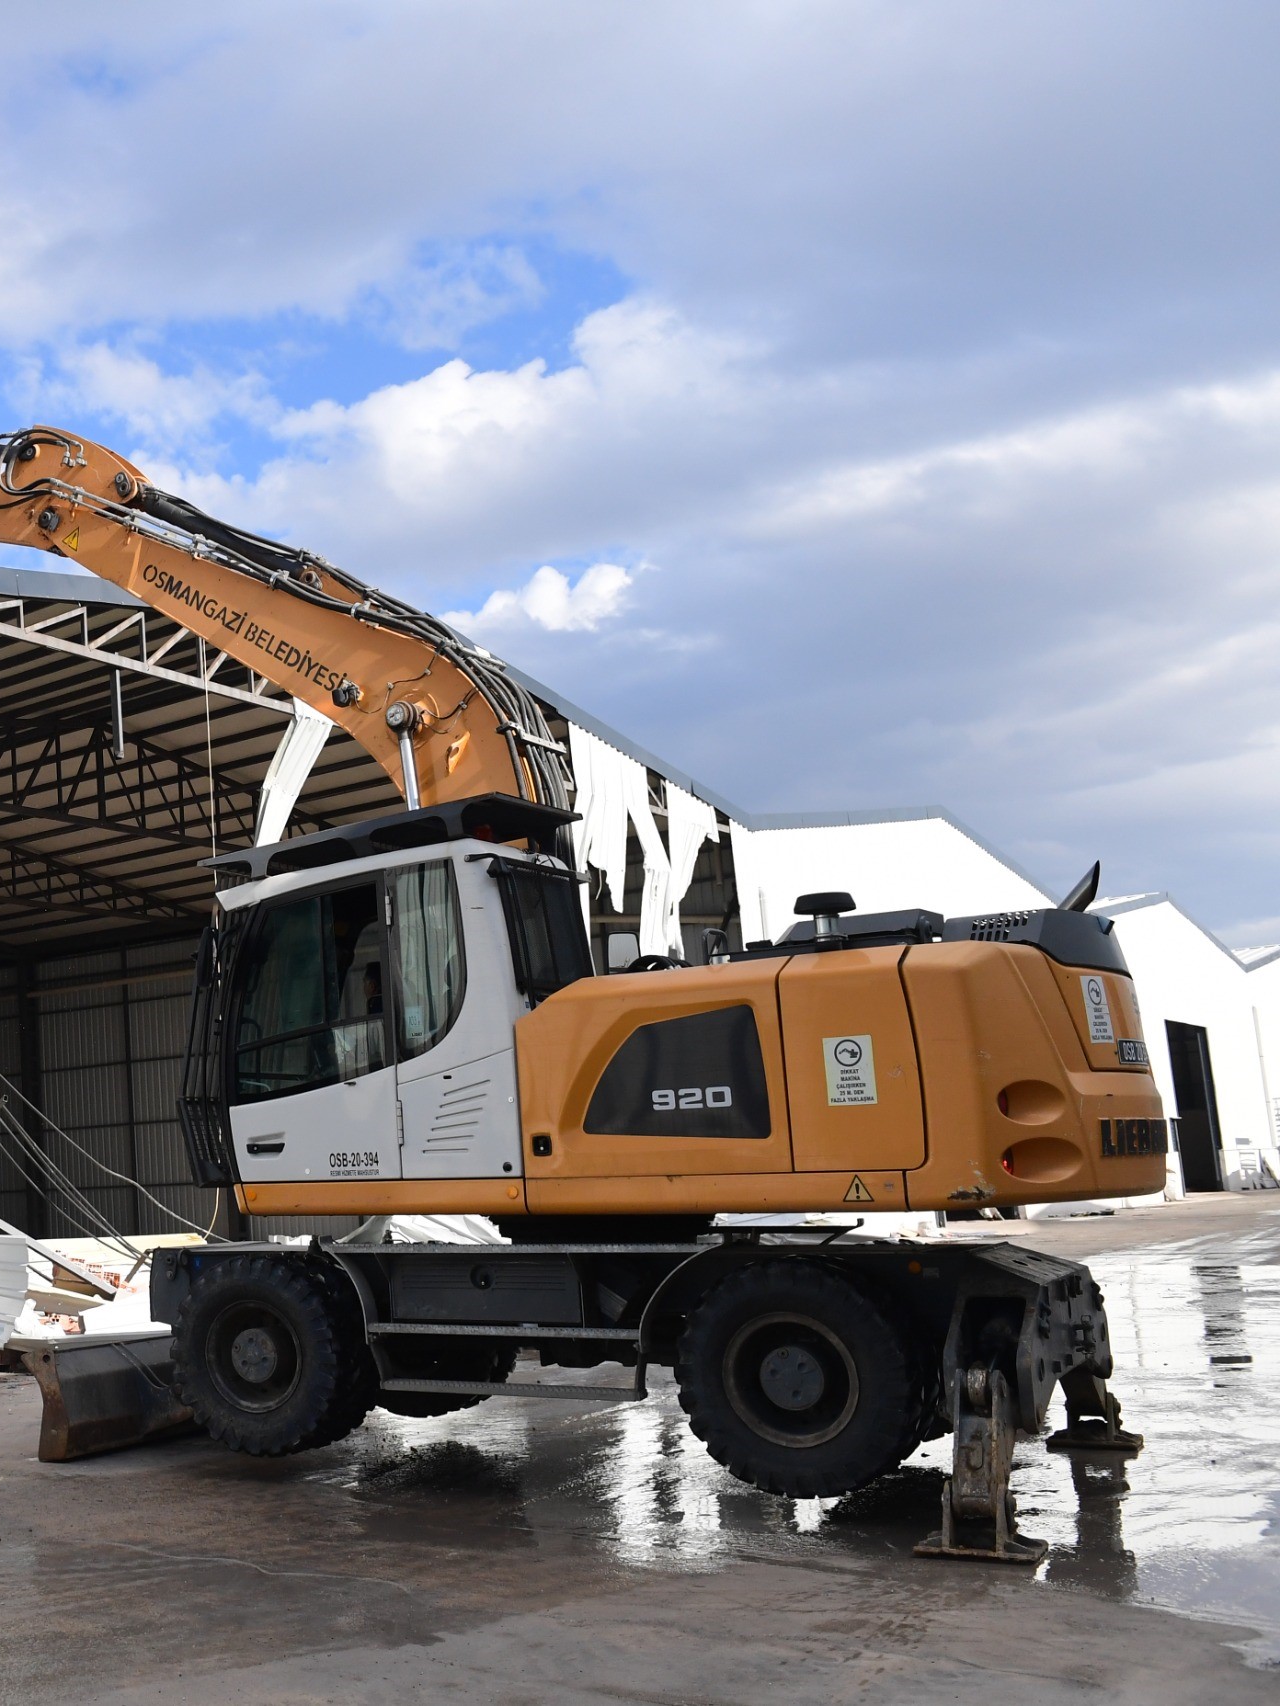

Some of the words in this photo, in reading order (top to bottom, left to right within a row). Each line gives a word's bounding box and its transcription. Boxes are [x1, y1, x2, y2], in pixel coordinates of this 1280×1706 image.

[143, 564, 248, 634] OSMANGAZİ
[651, 1086, 732, 1111] 920
[329, 1152, 379, 1168] OSB-20-394
